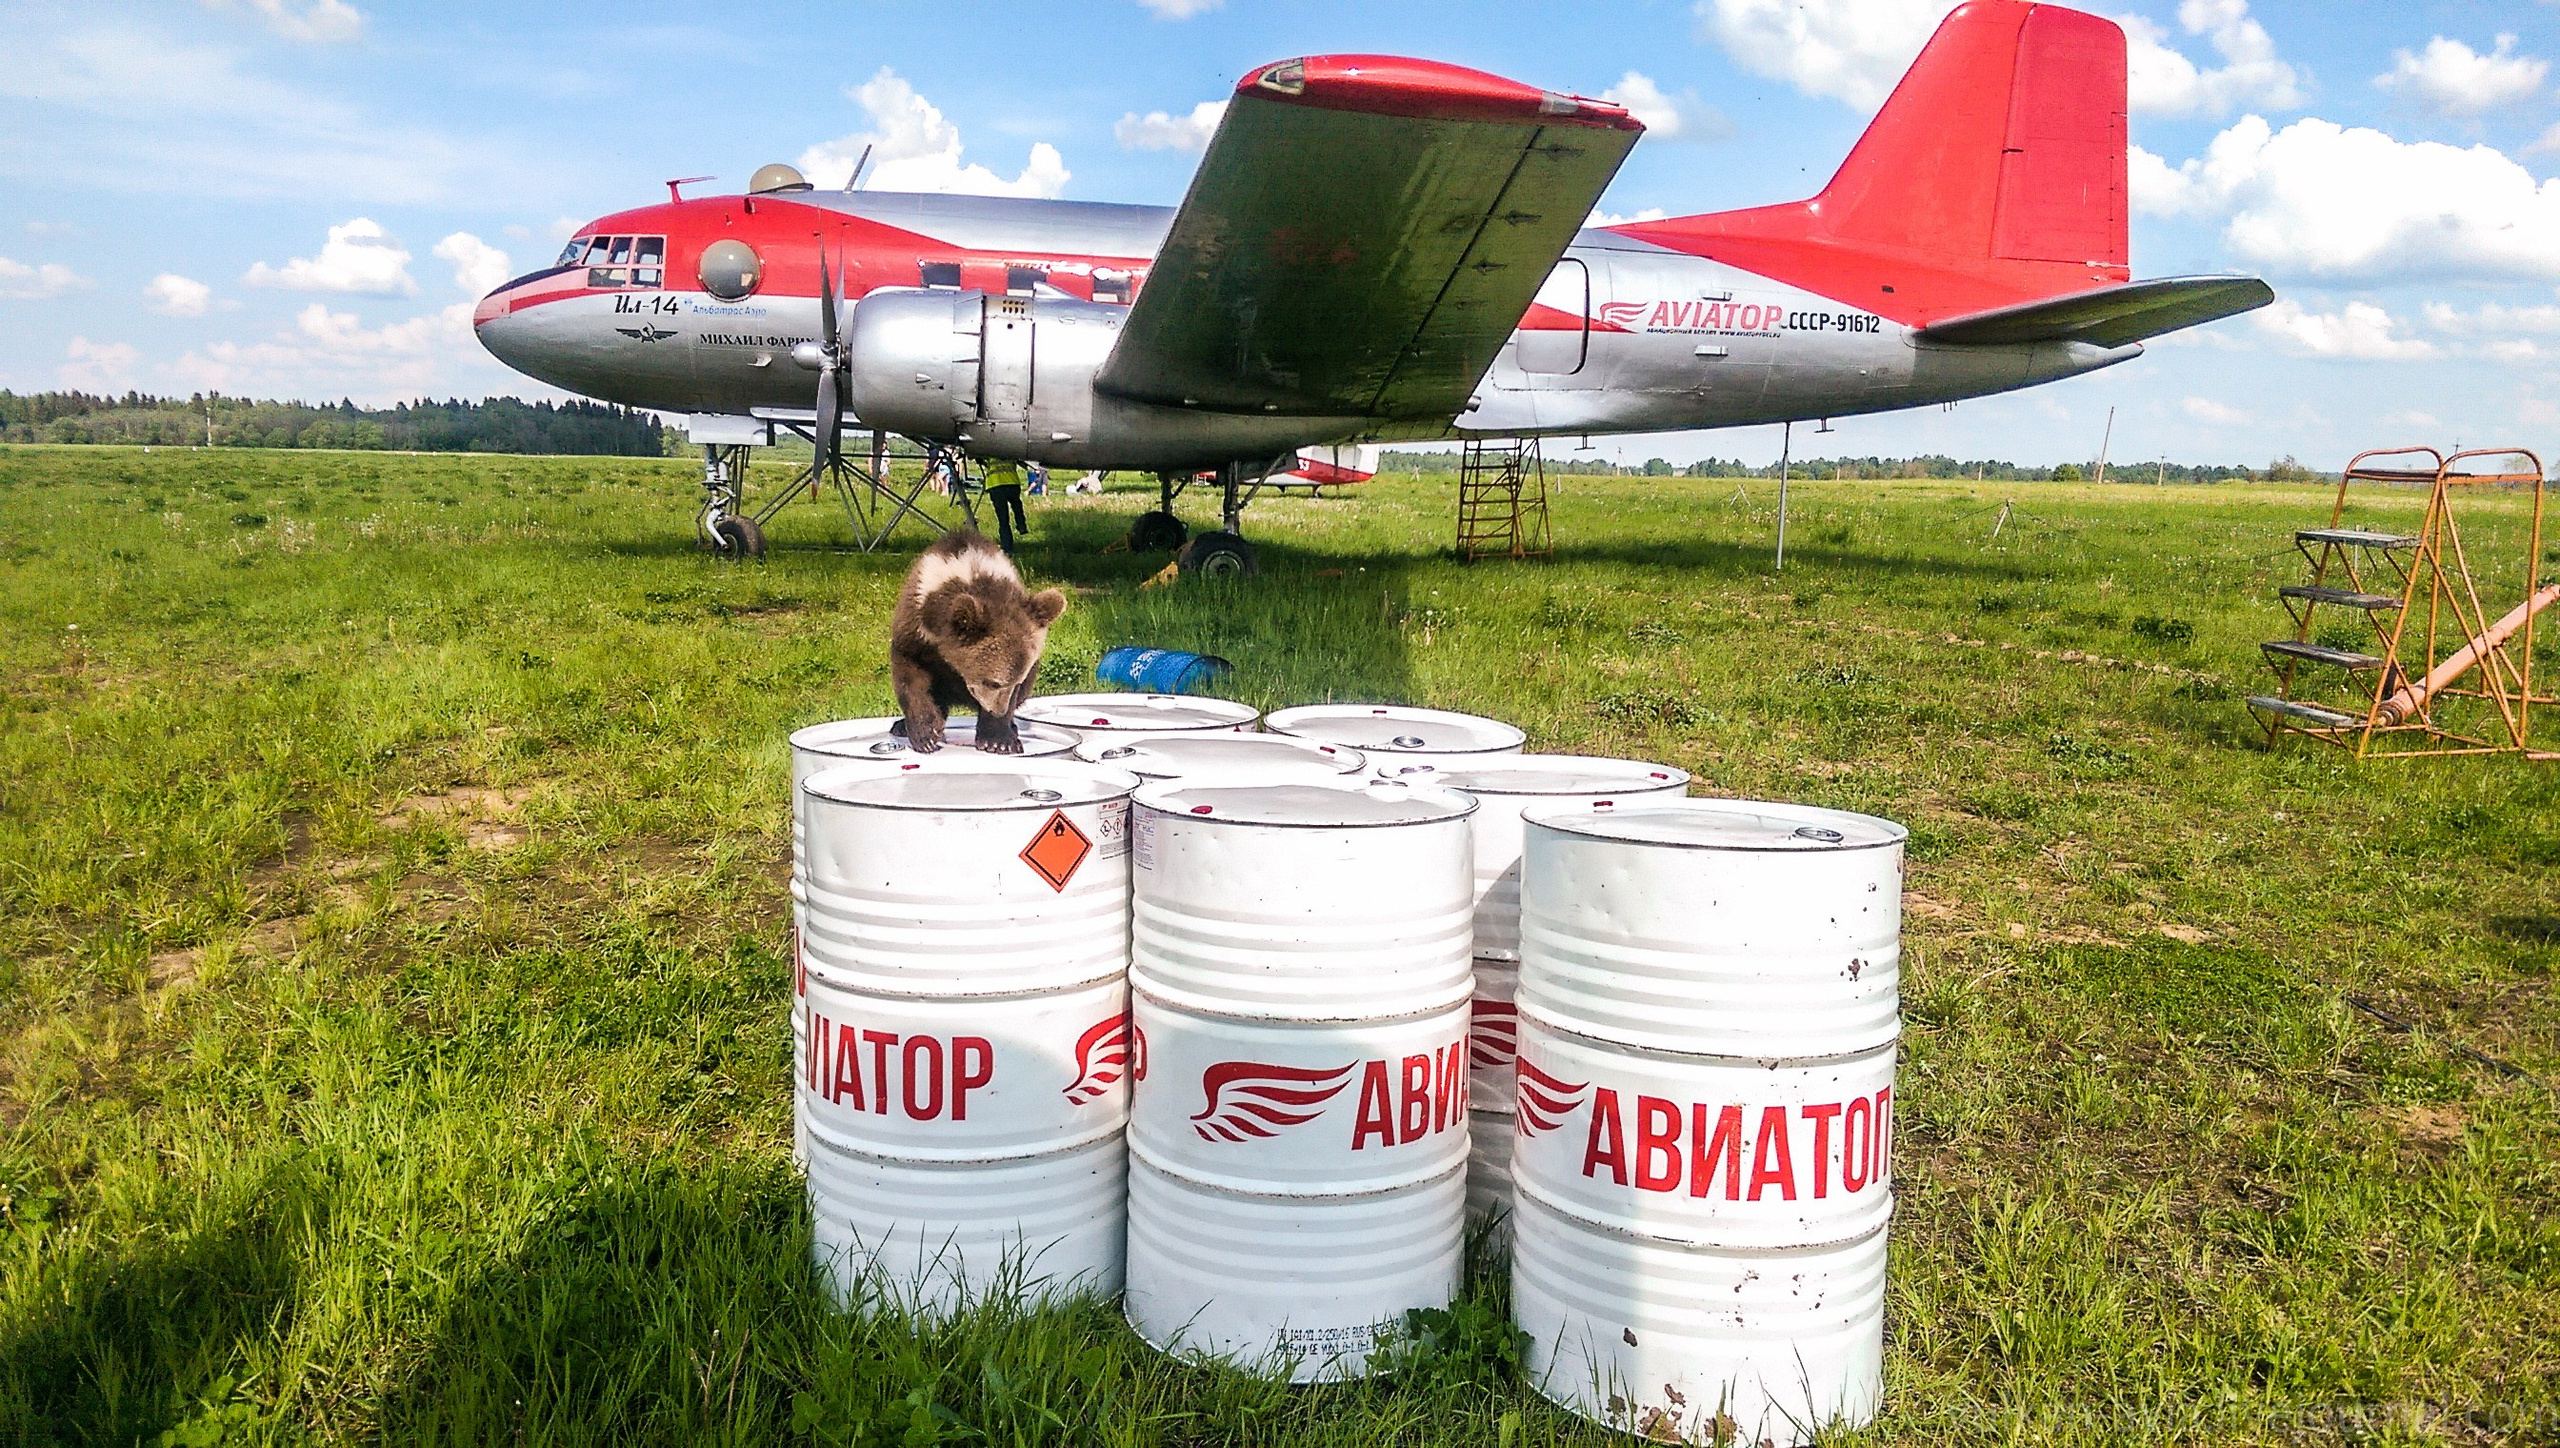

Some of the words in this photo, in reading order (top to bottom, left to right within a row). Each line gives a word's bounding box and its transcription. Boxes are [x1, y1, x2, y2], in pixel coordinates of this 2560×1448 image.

[615, 294, 679, 315] Ил-14
[1648, 300, 1783, 330] AVIATOP
[1789, 312, 1880, 334] СССР-91612
[700, 334, 763, 346] МИХАИЛ
